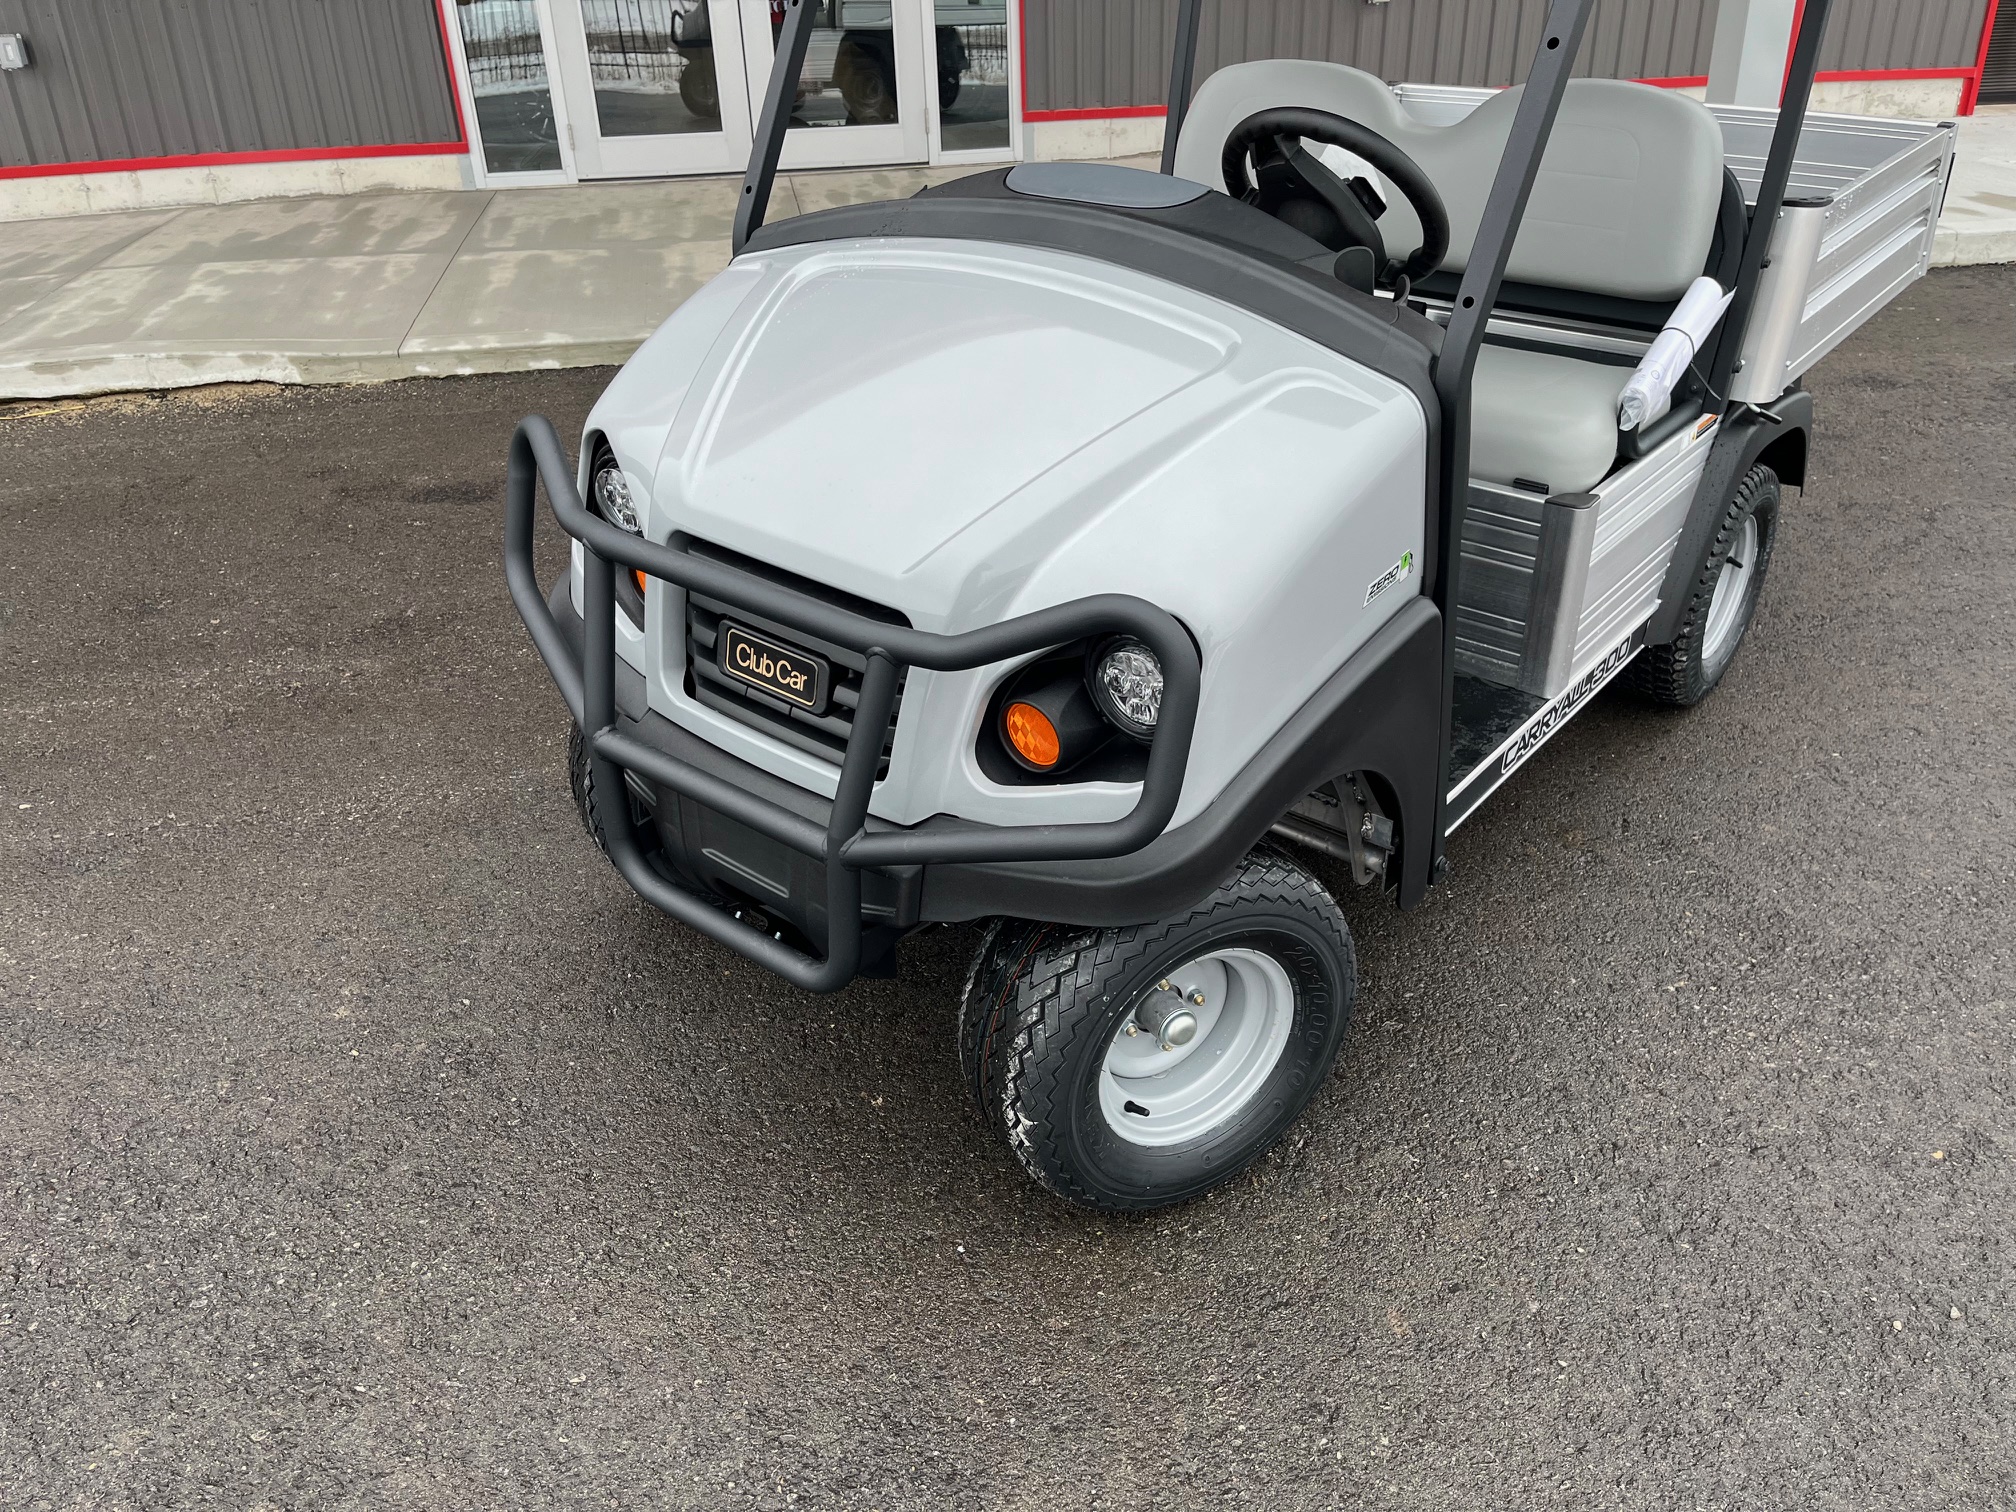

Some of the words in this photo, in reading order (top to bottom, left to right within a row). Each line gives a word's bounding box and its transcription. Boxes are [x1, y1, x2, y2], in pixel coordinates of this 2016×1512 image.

[1368, 564, 1400, 597] ZERO
[736, 643, 775, 678] Club
[776, 660, 808, 692] Car
[1501, 674, 1591, 774] CARRYALL
[1591, 633, 1632, 689] 300
